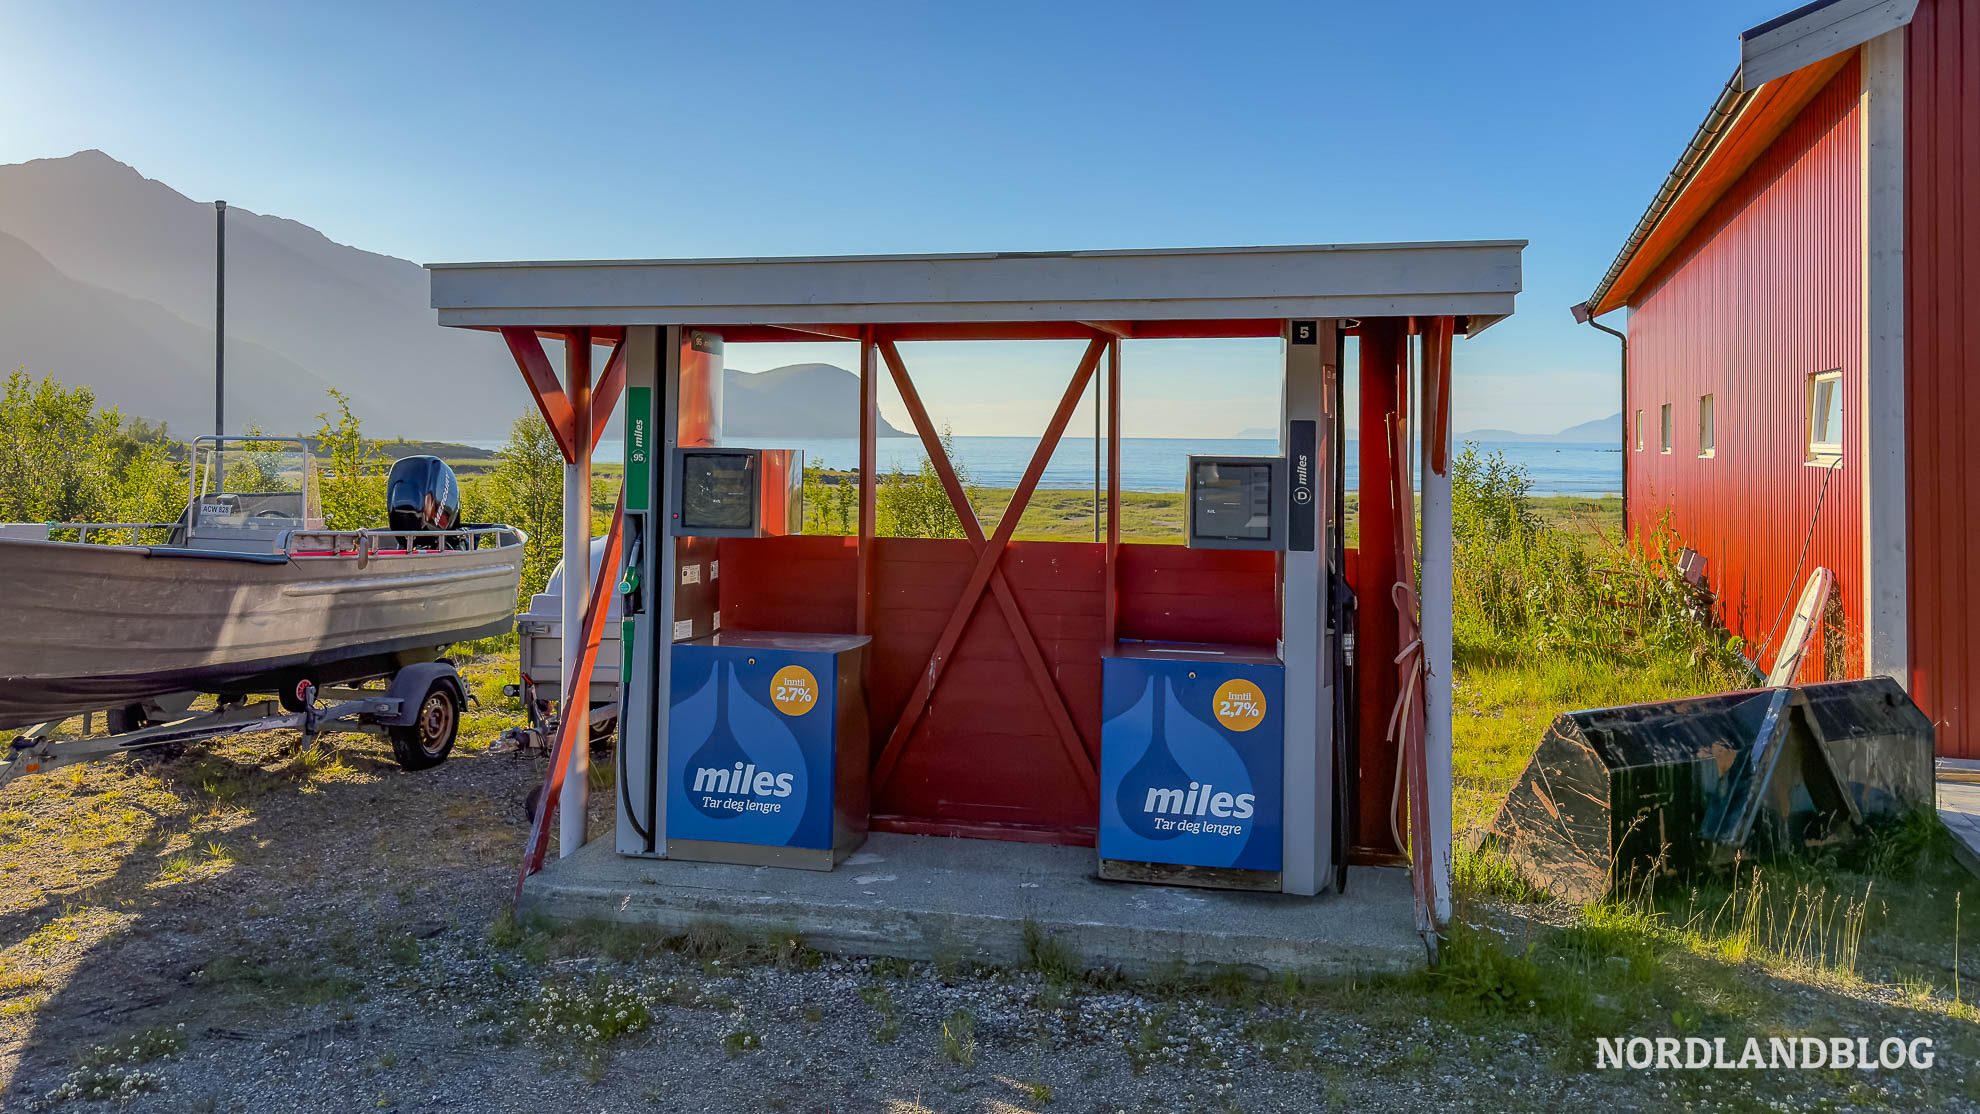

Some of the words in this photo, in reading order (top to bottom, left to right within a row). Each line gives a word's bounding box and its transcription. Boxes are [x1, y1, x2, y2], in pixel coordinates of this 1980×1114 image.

[1300, 326, 1309, 338] 5
[634, 419, 643, 447] miles
[633, 453, 644, 462] 95
[1297, 454, 1307, 485] miles
[1297, 491, 1308, 500] D
[202, 505, 217, 513] ACW
[784, 678, 805, 686] Inntil
[776, 686, 812, 702] 2,7%
[1228, 691, 1251, 701] Inntil
[1219, 700, 1260, 718] 2,7%
[693, 761, 794, 797] miles
[702, 796, 723, 808] Tar
[723, 798, 744, 812] deg
[746, 799, 781, 814] lengre
[1143, 781, 1256, 819] miles
[1154, 817, 1175, 830] Tar
[1177, 819, 1201, 834] deg
[1202, 820, 1242, 837] lengre
